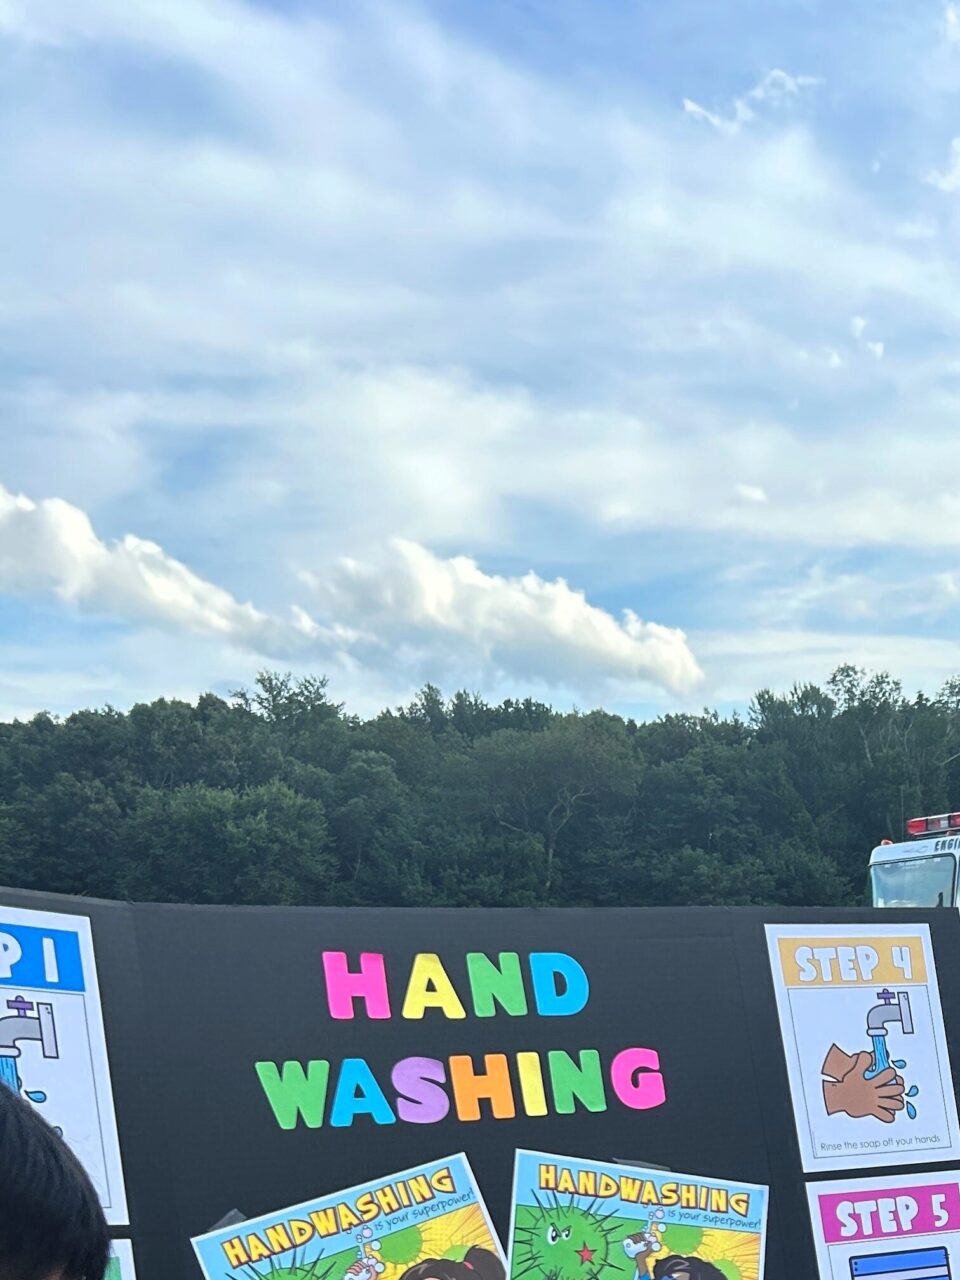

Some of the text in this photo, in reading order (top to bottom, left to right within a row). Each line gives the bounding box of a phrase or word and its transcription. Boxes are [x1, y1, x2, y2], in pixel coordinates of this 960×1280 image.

[321, 951, 590, 1020] HAND
[794, 945, 913, 982] STEP 4
[255, 1047, 667, 1130] WASHING
[820, 1142, 842, 1151] Rinse
[844, 1141, 858, 1150] the
[860, 1140, 880, 1149] soap
[882, 1138, 894, 1147] off
[895, 1137, 913, 1147] your
[374, 1187, 476, 1233] is your superpower!
[539, 1163, 751, 1218] HANDWASHING
[221, 1166, 458, 1270] HANDWASHING
[667, 1208, 762, 1231] is your superpower!
[836, 1193, 949, 1237] STEP 5
